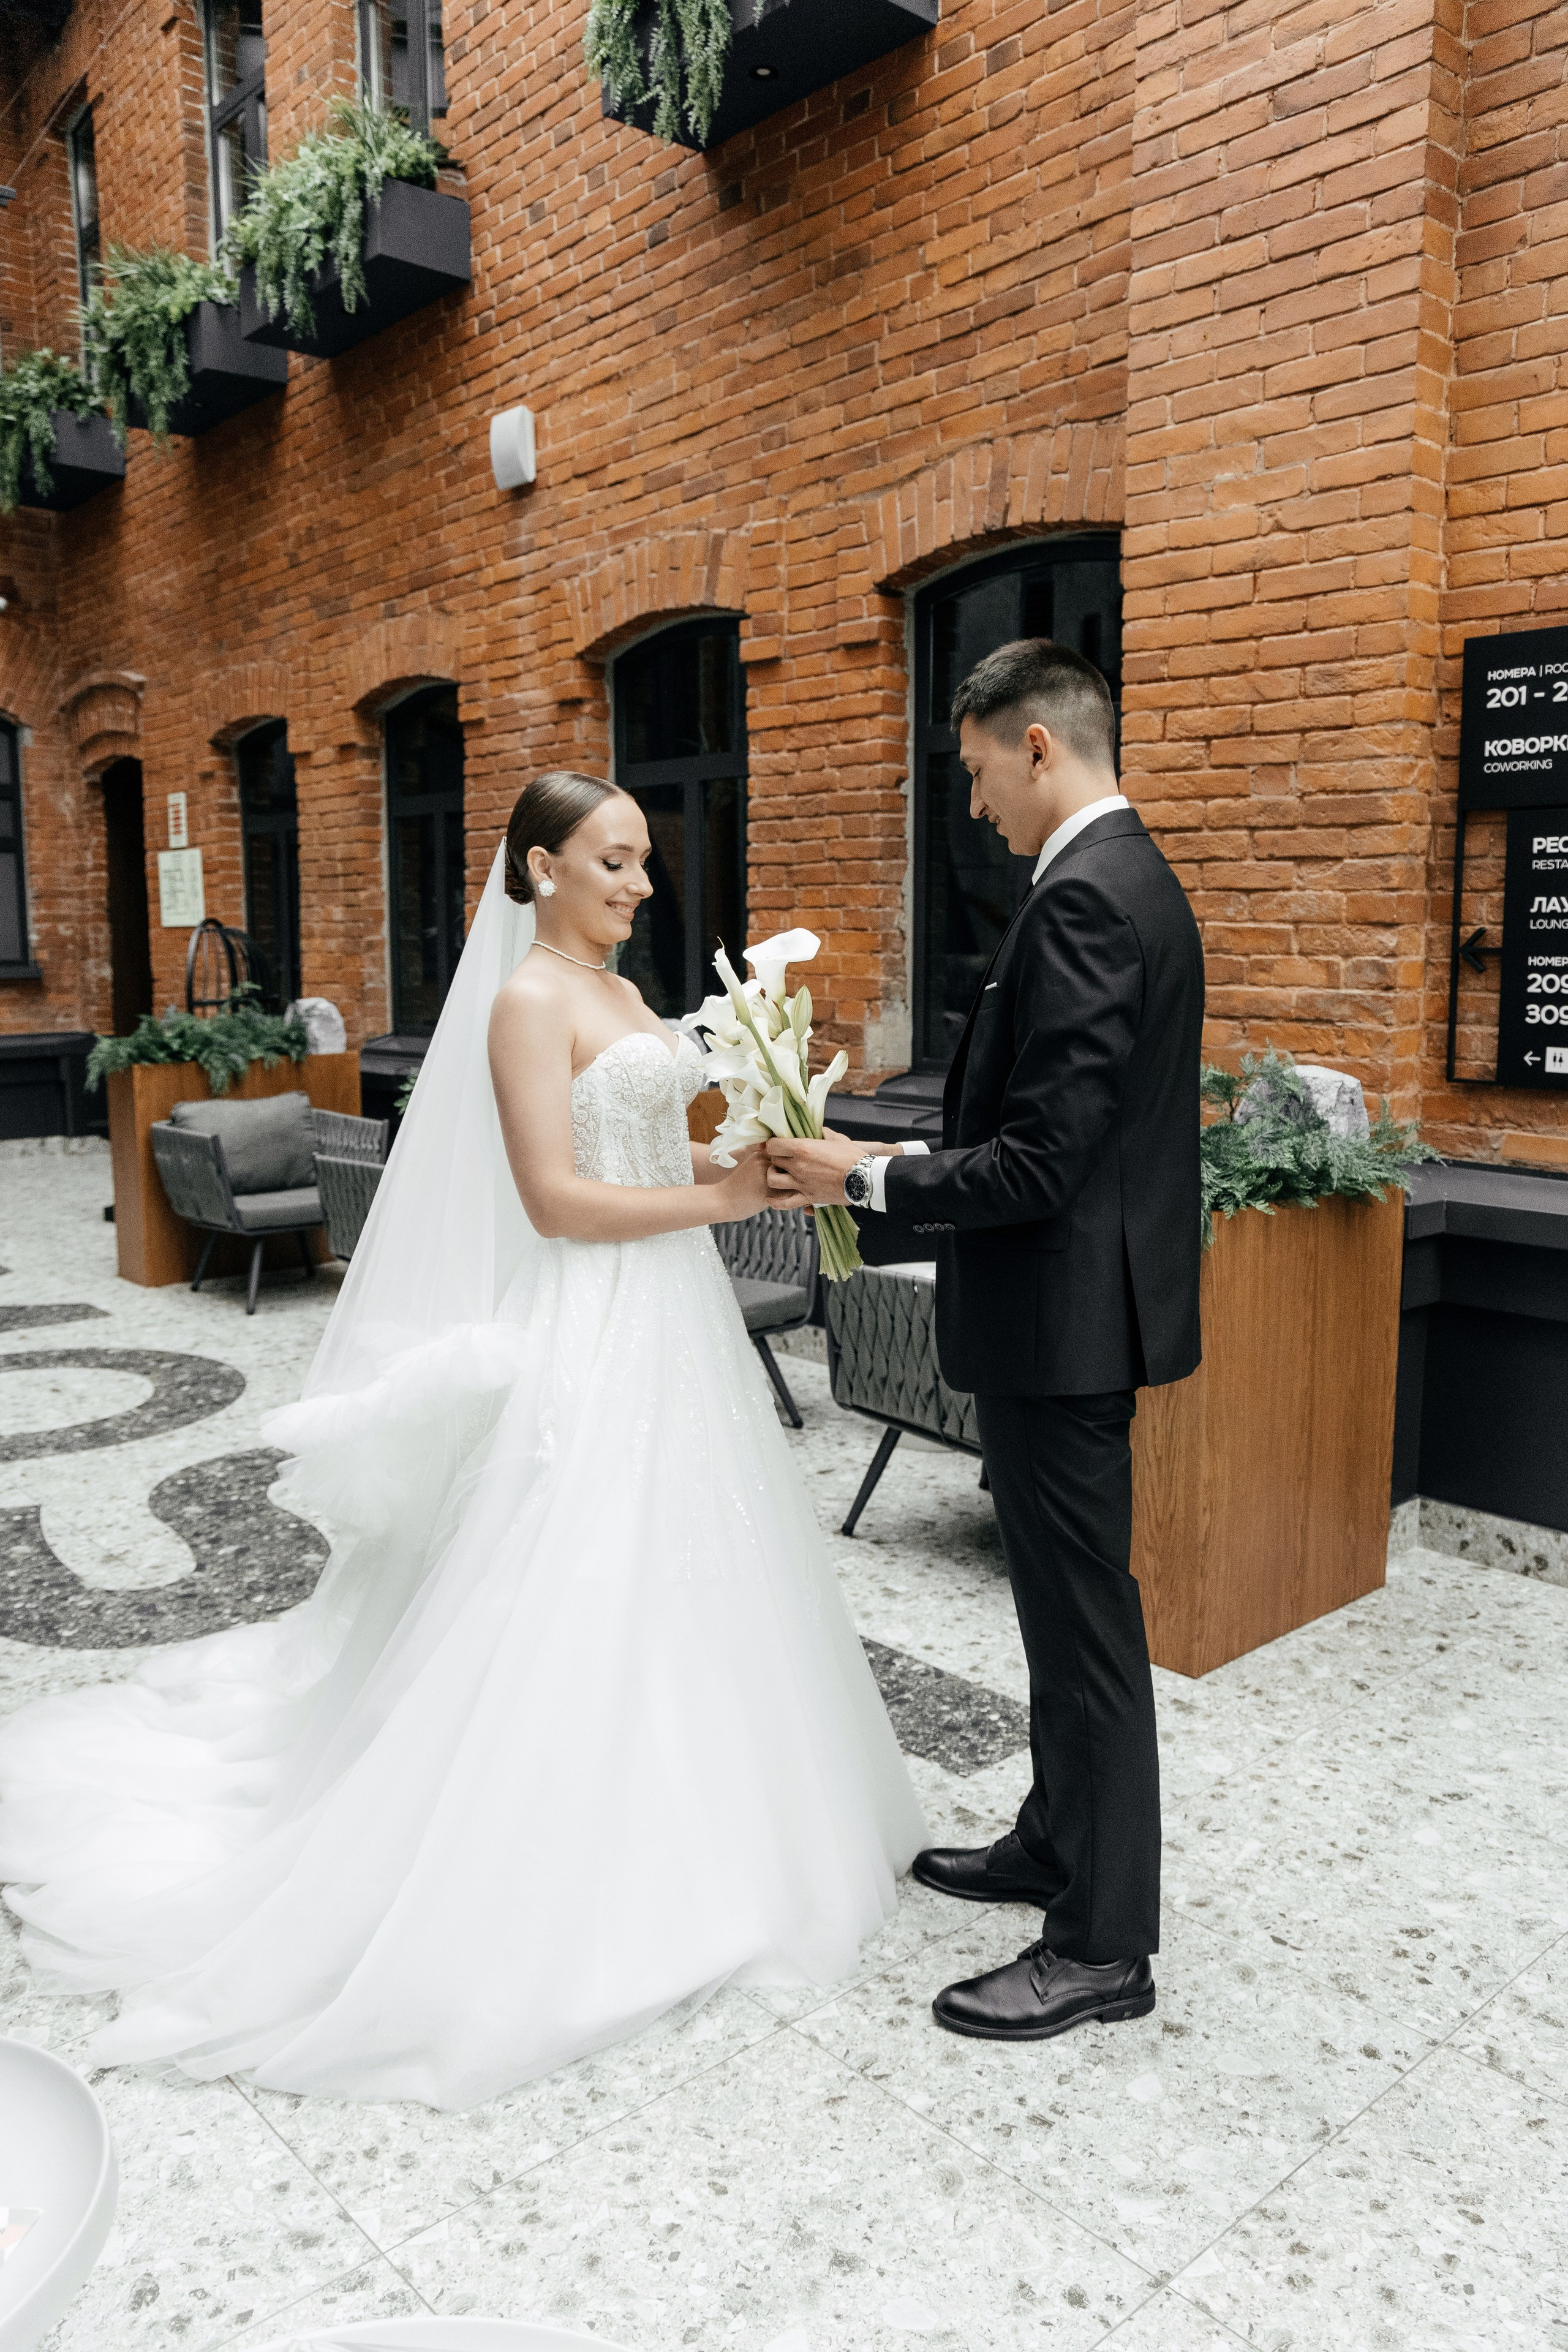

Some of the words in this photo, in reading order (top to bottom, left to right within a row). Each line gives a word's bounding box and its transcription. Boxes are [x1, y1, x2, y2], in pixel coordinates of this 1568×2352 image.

[1487, 666, 1536, 681] НОМЕРА
[1486, 685, 1527, 709] 201
[1552, 681, 1568, 703] 2
[1484, 734, 1568, 757] КОВОРК
[1483, 758, 1553, 774] COWORKING
[1532, 859, 1568, 870] RESTA
[1529, 919, 1568, 930] LOUNG
[1528, 956, 1568, 967] НОМЕР
